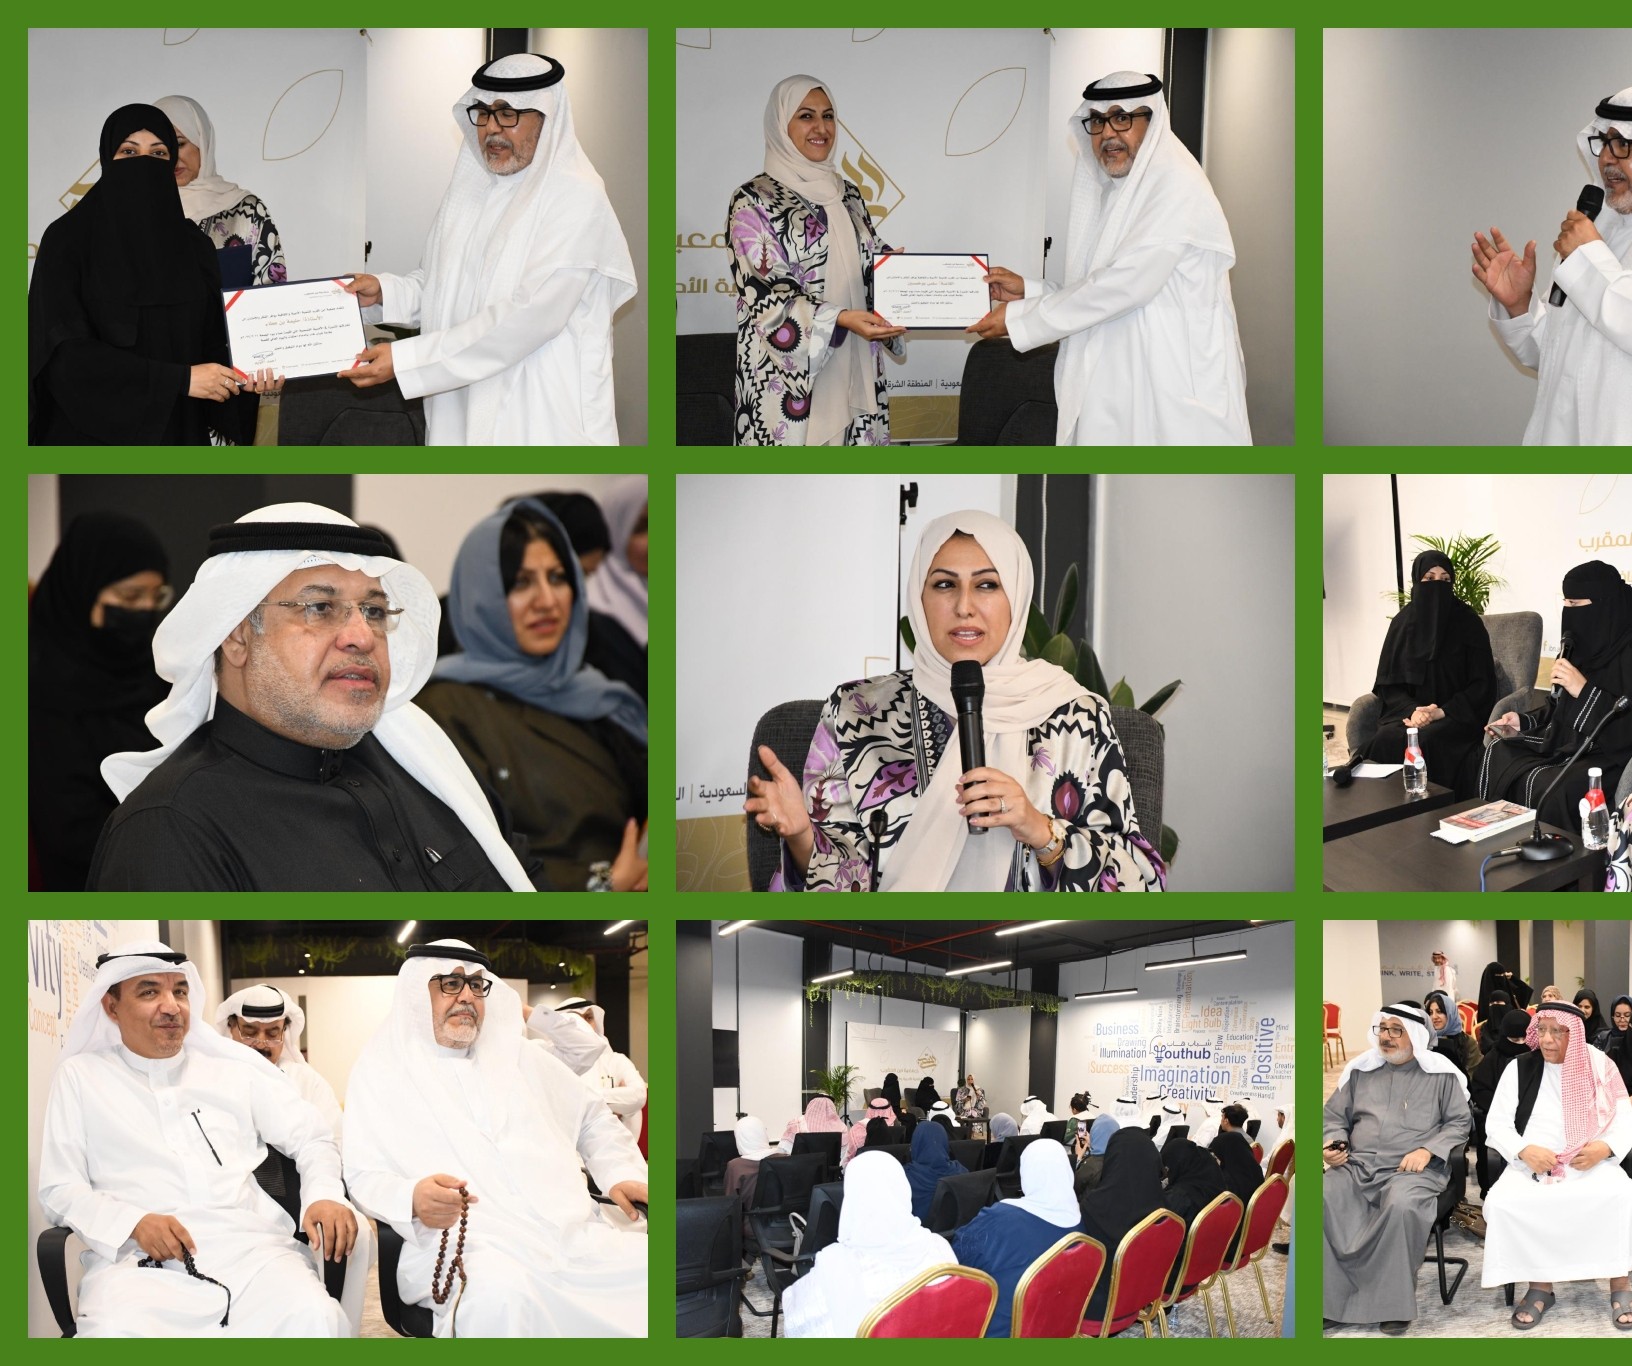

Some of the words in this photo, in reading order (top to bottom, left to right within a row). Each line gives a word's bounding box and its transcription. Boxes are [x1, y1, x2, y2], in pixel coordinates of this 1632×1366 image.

[676, 277, 707, 293] الأد
[887, 380, 905, 390] الشرق
[699, 782, 747, 803] لسعودية
[28, 920, 62, 1020] vity
[1399, 970, 1424, 978] WRITE,
[1183, 971, 1193, 1018] Presentation
[1174, 994, 1183, 1034] Brainstorming
[1201, 1005, 1223, 1018] Idea
[1096, 1022, 1140, 1036] Business
[1182, 1019, 1201, 1031] Light
[1203, 1018, 1222, 1029] Bulb
[1117, 1038, 1147, 1049] Drawing
[1215, 1034, 1223, 1051] Flow
[1275, 1043, 1294, 1052] Entr
[1099, 1047, 1147, 1059] Illumination
[1251, 1017, 1275, 1084] Positive
[1213, 1052, 1247, 1064] Genius
[1090, 1060, 1130, 1074] Success
[1140, 1065, 1231, 1087] Imagination
[1131, 1066, 1140, 1101] adership
